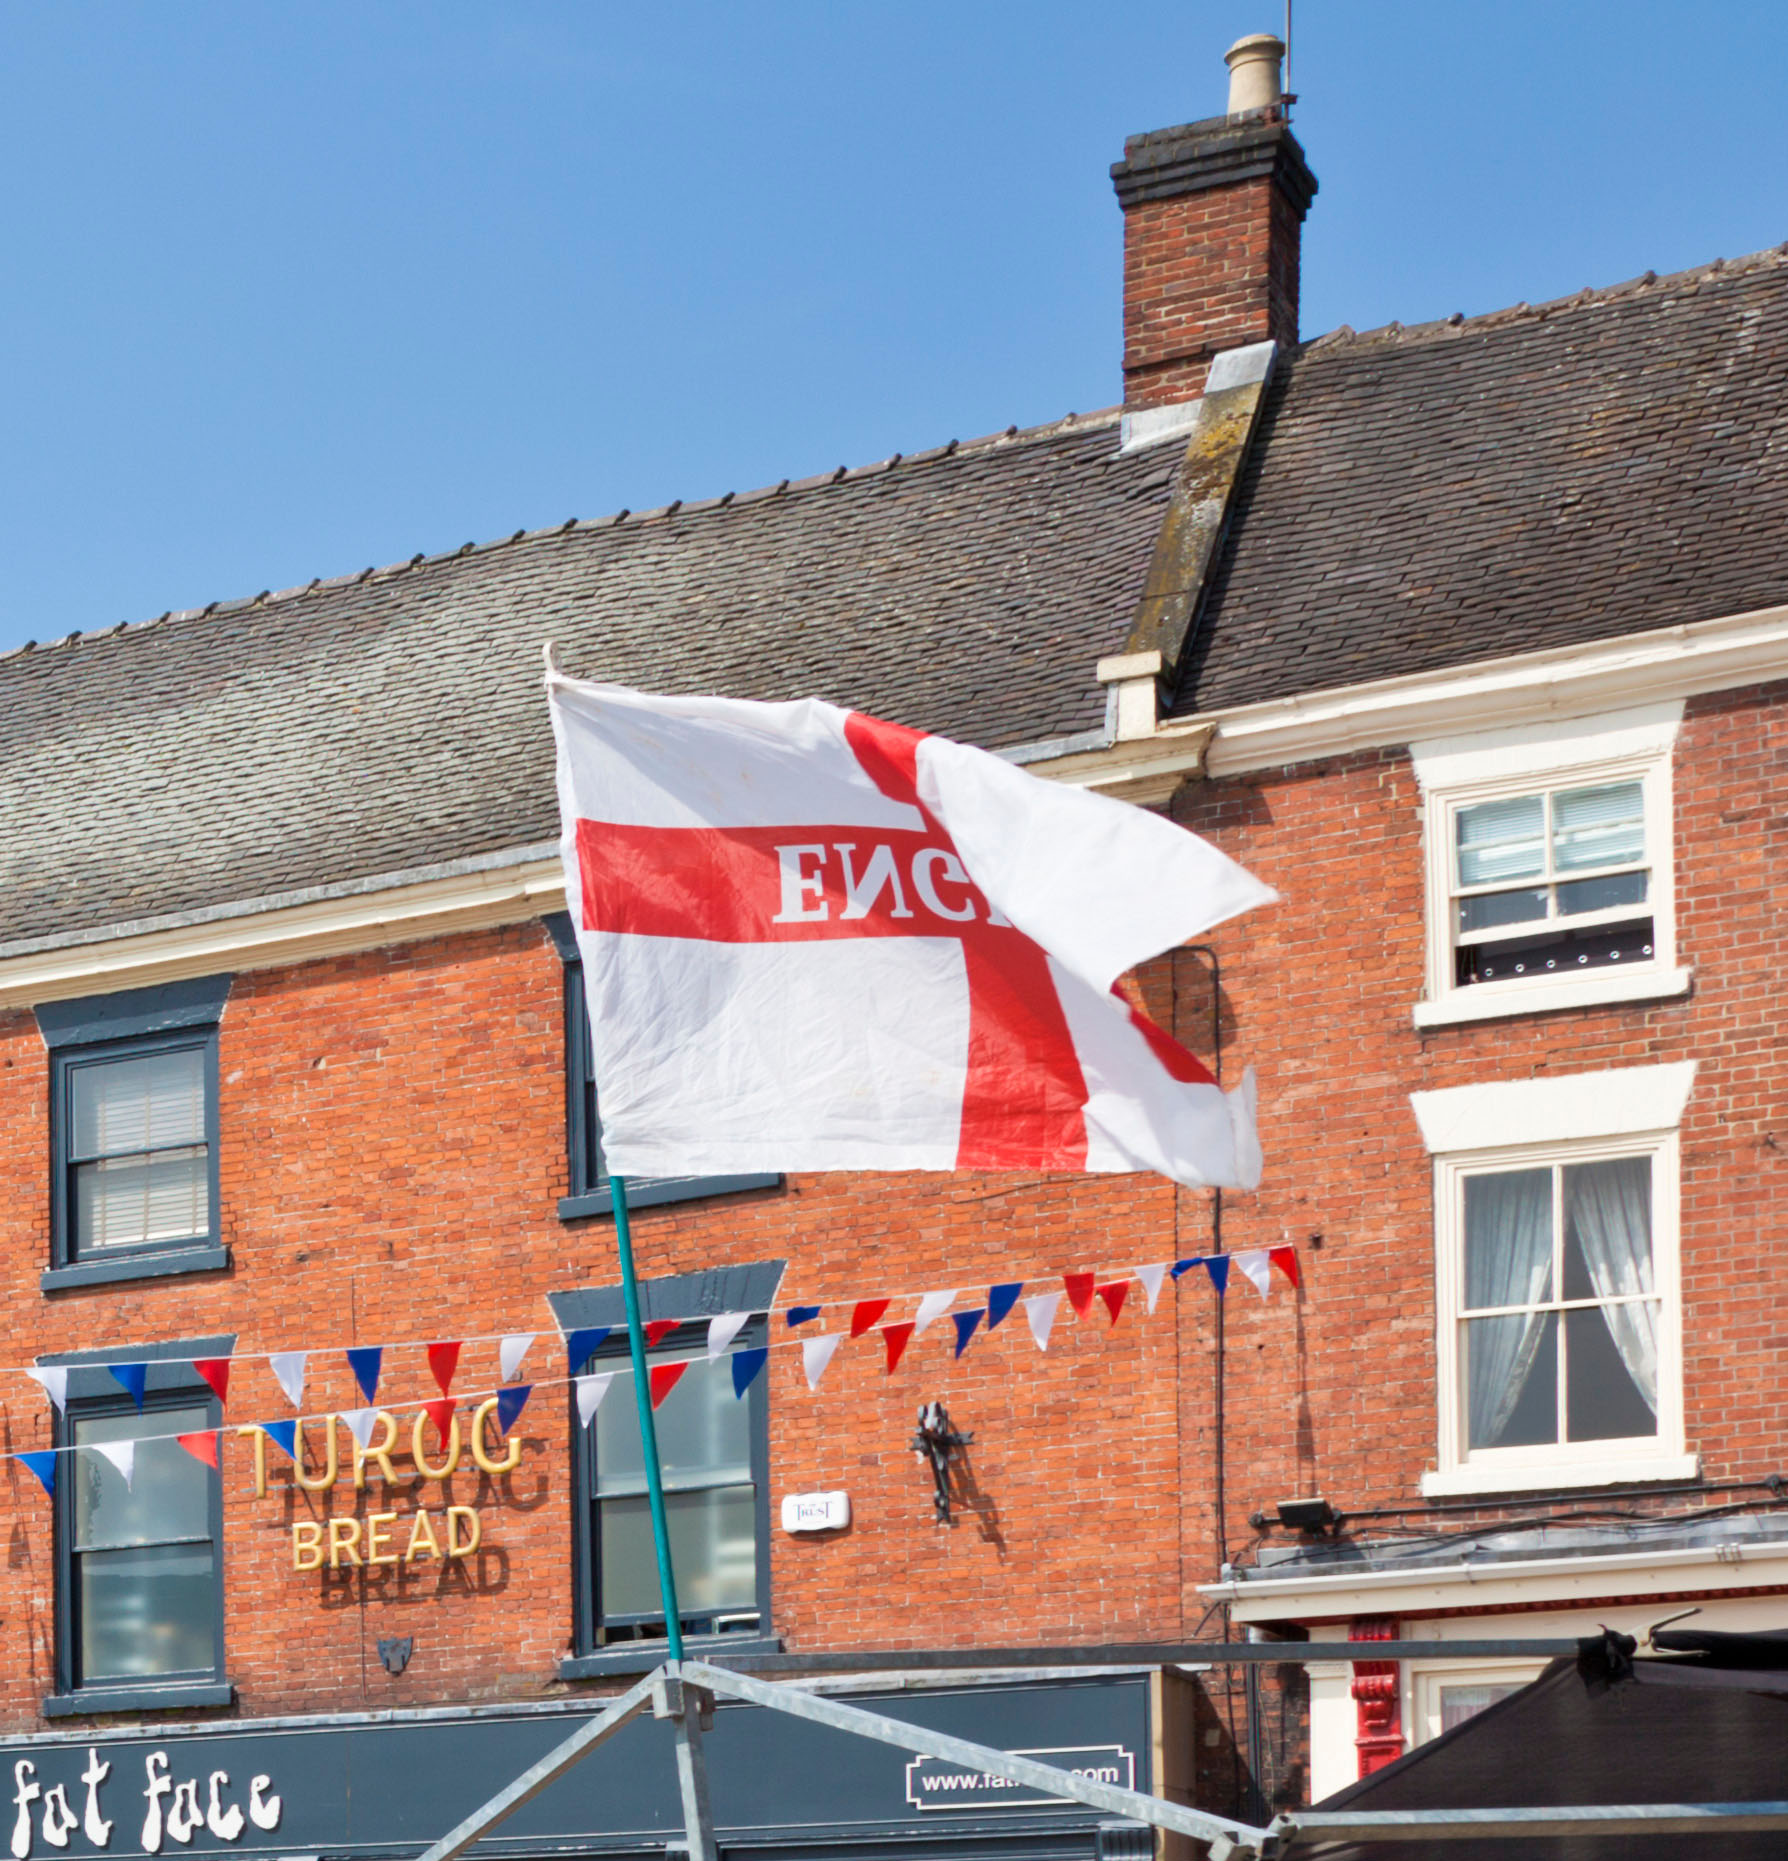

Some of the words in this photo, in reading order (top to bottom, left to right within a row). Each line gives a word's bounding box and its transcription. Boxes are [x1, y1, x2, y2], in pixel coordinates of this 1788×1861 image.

[238, 1397, 521, 1499] TUROG
[292, 1506, 481, 1571] BREAD
[11, 1747, 113, 1859] fat
[141, 1751, 281, 1853] face
